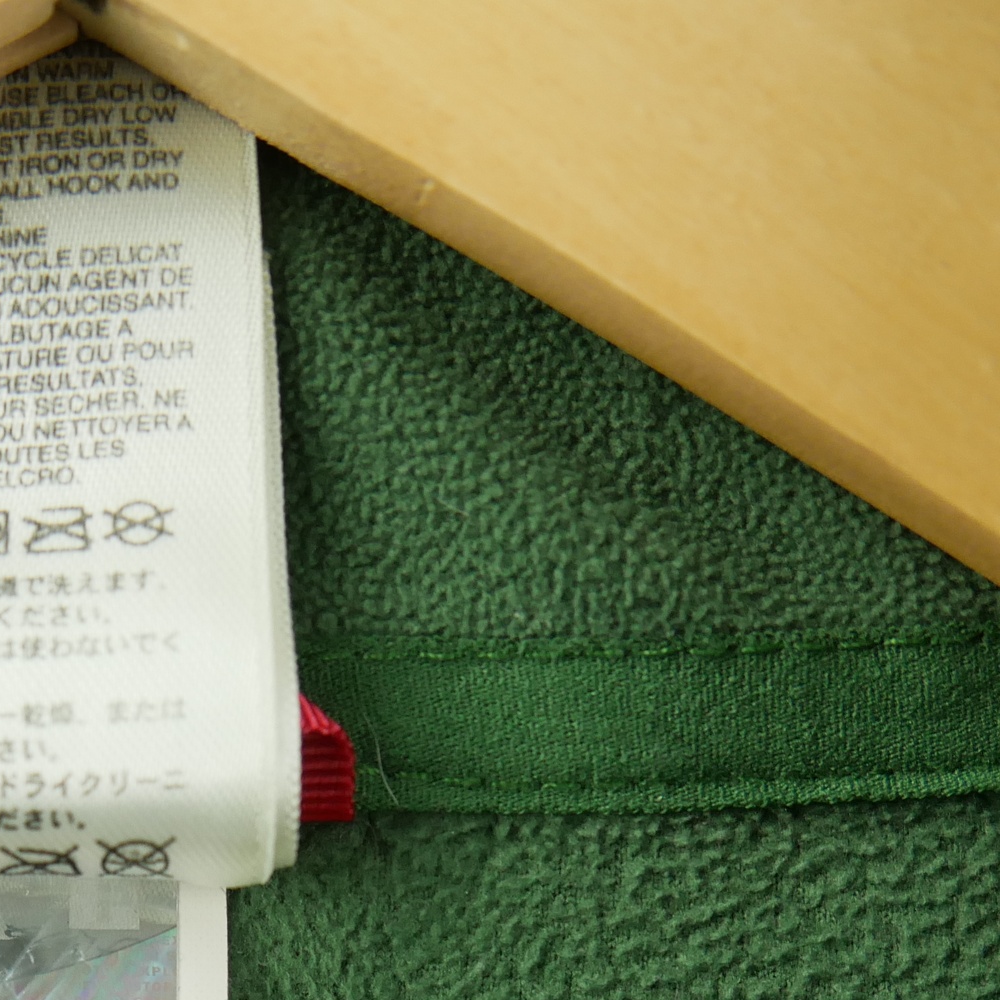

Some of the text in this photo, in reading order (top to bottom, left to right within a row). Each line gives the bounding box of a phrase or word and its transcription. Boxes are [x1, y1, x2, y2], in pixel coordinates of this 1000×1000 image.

[36, 61, 115, 82] WARM
[47, 83, 144, 105] BLEACH
[63, 106, 113, 127] DRY
[122, 104, 177, 124] LOW
[19, 153, 80, 177] IRON
[87, 151, 126, 171] OR
[133, 149, 184, 169] DRY
[48, 173, 121, 195] HOOK
[128, 172, 180, 191] AND
[80, 243, 183, 267] DELICAT
[67, 268, 151, 291] AGENT
[161, 266, 193, 286] DE
[117, 319, 133, 336] A
[76, 344, 113, 364] OU
[123, 341, 194, 362] POUR
[154, 388, 187, 409] NE
[34, 414, 170, 440] NETTOYER
[177, 414, 194, 431] A
[79, 439, 126, 460] LES
